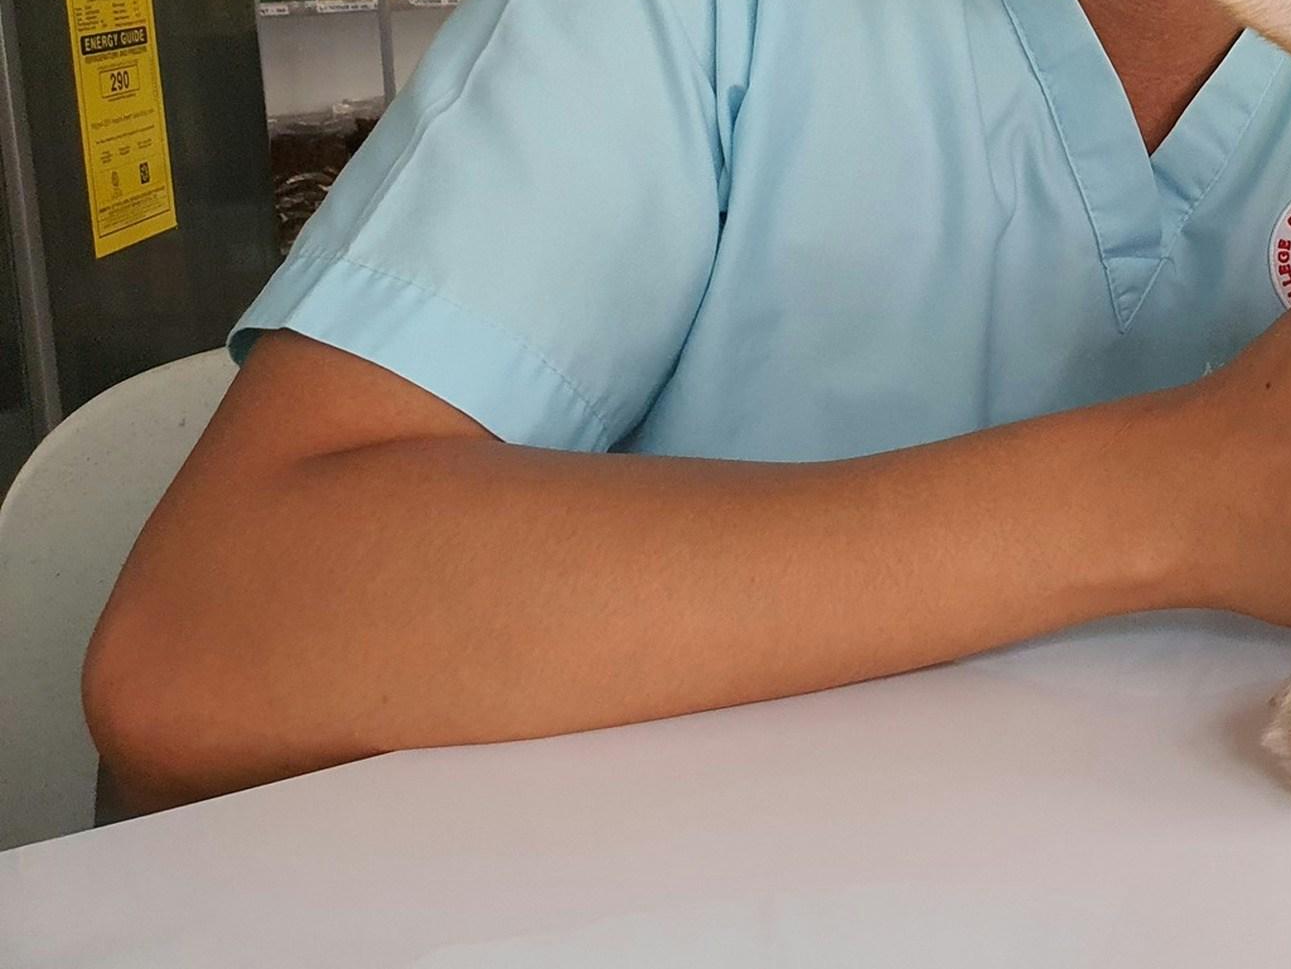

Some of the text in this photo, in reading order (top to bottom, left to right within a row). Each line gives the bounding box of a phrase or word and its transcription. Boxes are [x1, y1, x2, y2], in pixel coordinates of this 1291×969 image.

[84, 28, 145, 52] ENERGY GUIDE
[110, 70, 130, 92] 290
